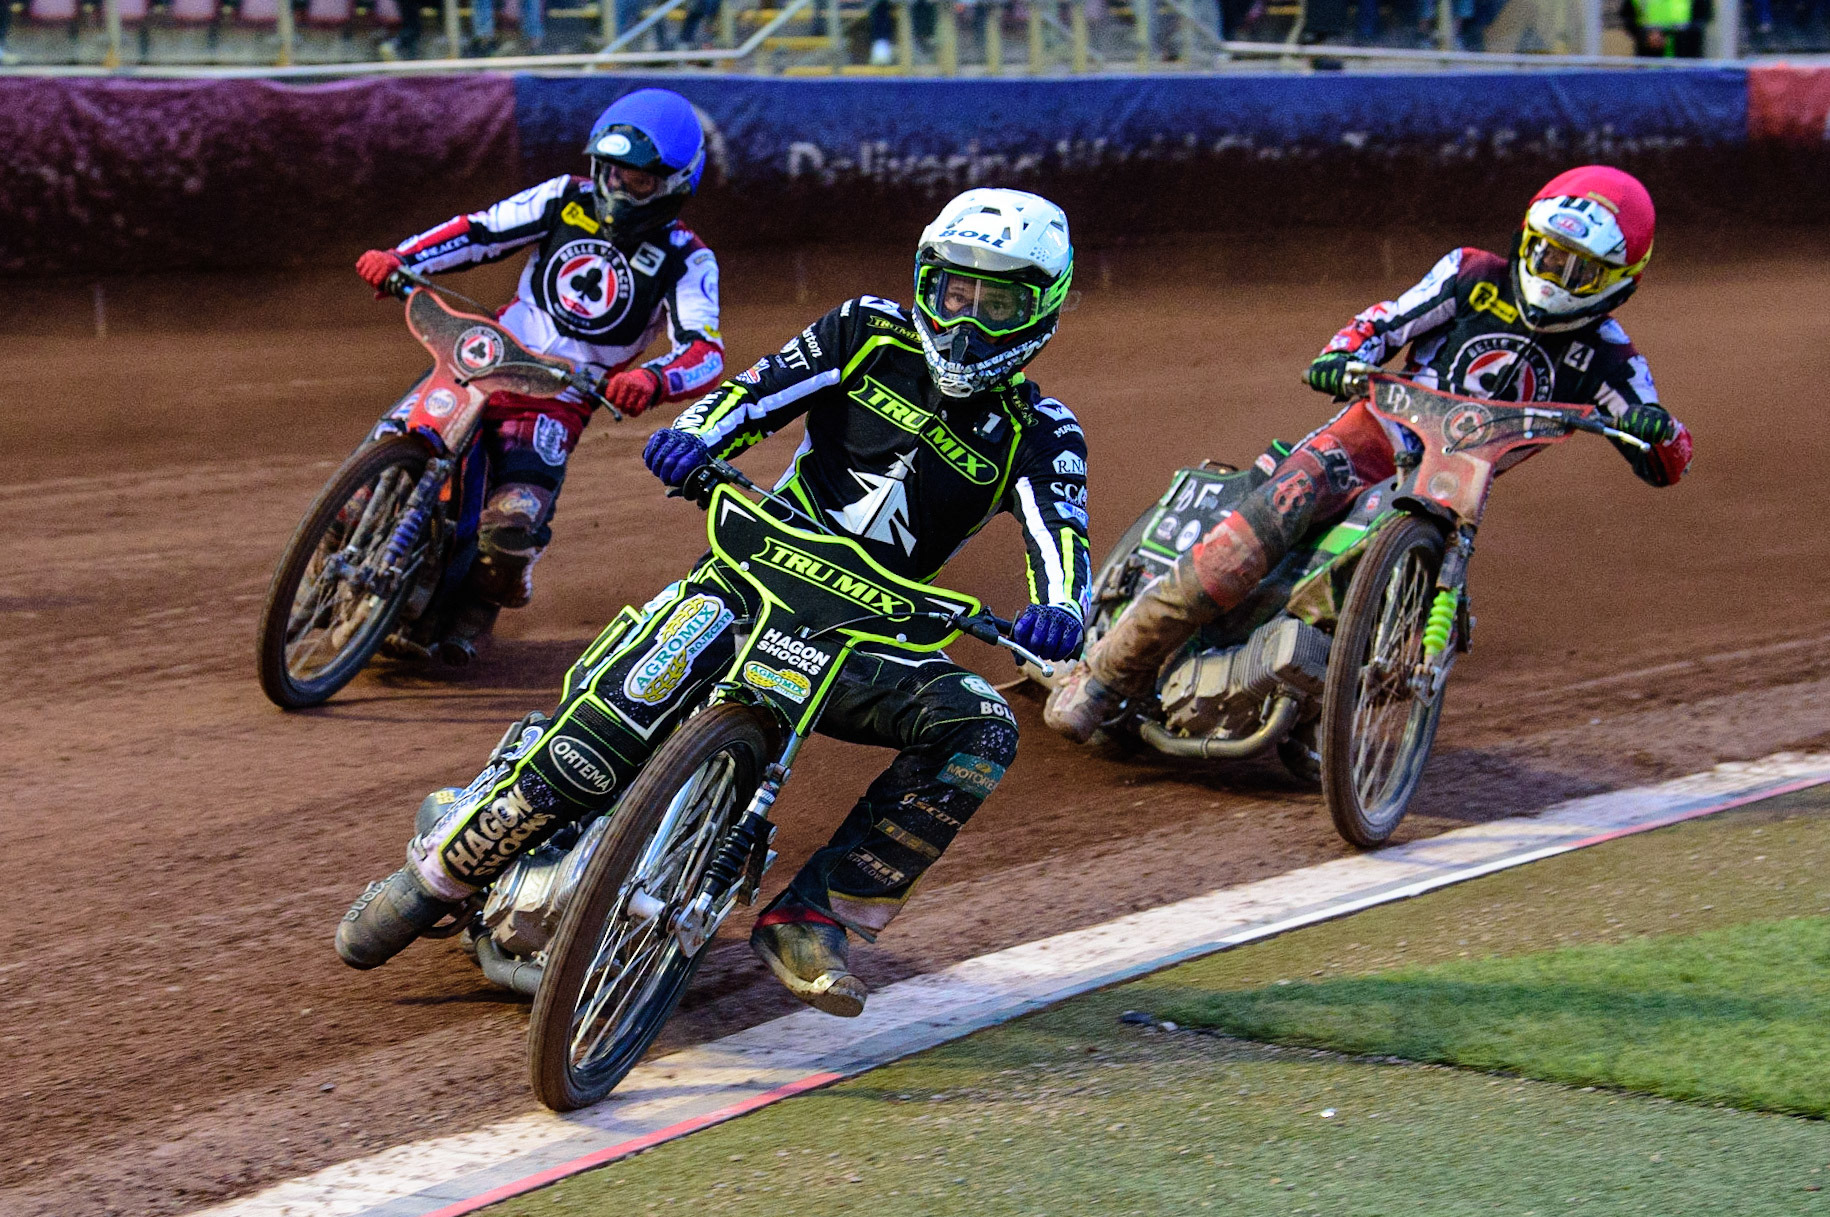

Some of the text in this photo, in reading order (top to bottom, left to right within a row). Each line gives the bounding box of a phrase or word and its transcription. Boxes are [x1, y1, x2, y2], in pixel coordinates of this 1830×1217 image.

[938, 229, 1005, 249] BOLL
[560, 244, 596, 262] BELLE
[617, 268, 629, 299] ACES
[1467, 338, 1510, 358] BELLE
[1536, 367, 1550, 402] ACES
[1567, 343, 1589, 371] 4
[867, 387, 988, 477] TRU MIX
[982, 412, 1002, 434] 1
[770, 546, 904, 615] TRU MIX
[637, 604, 716, 690] AGROMIX
[757, 640, 821, 676] SHOCKS
[763, 628, 831, 667] HAGON
[751, 665, 806, 696] AGROMIX
[554, 741, 612, 792] ORTEMA
[446, 783, 533, 876] HAGON
[473, 812, 556, 877] SHOCKS
[847, 852, 895, 887] SPEEDWAY
